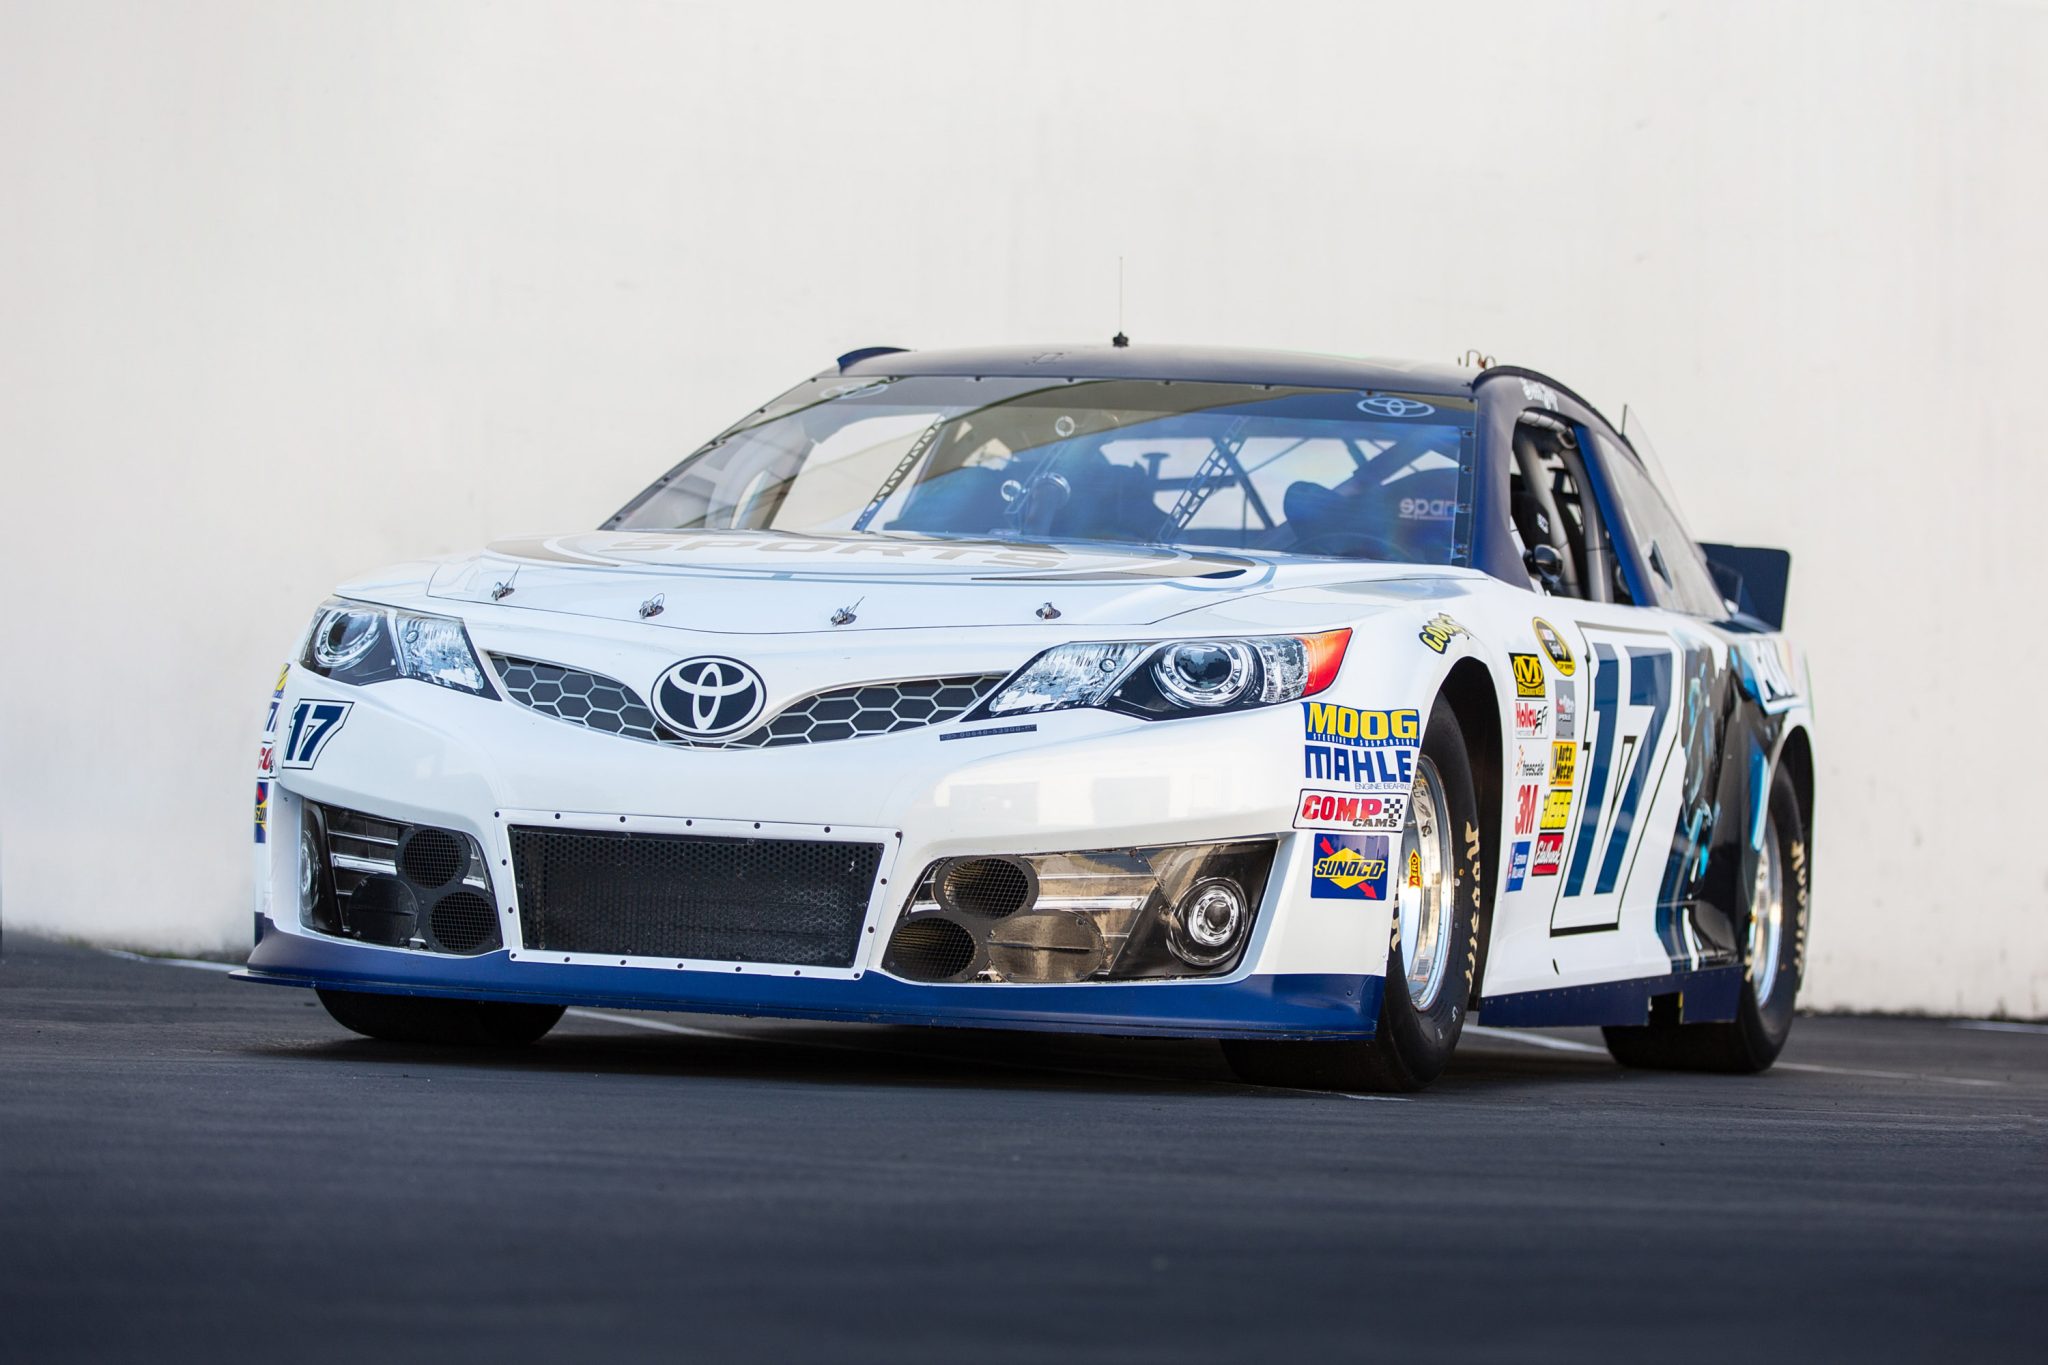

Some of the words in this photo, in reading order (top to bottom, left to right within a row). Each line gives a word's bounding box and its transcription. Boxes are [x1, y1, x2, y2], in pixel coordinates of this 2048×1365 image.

[1399, 498, 1457, 520] spar
[601, 538, 1064, 569] SPORTS
[285, 703, 345, 763] 17
[1307, 702, 1418, 739] MOOG
[1305, 745, 1412, 783] MAHLE
[1563, 642, 1673, 897] 17
[1355, 783, 1381, 791] ENGINE
[1302, 795, 1383, 822] COMP
[1352, 818, 1398, 828] CAMS
[1515, 784, 1539, 835] 3M
[1316, 859, 1383, 877] SUNOCO
[1411, 856, 1419, 886] AERO
